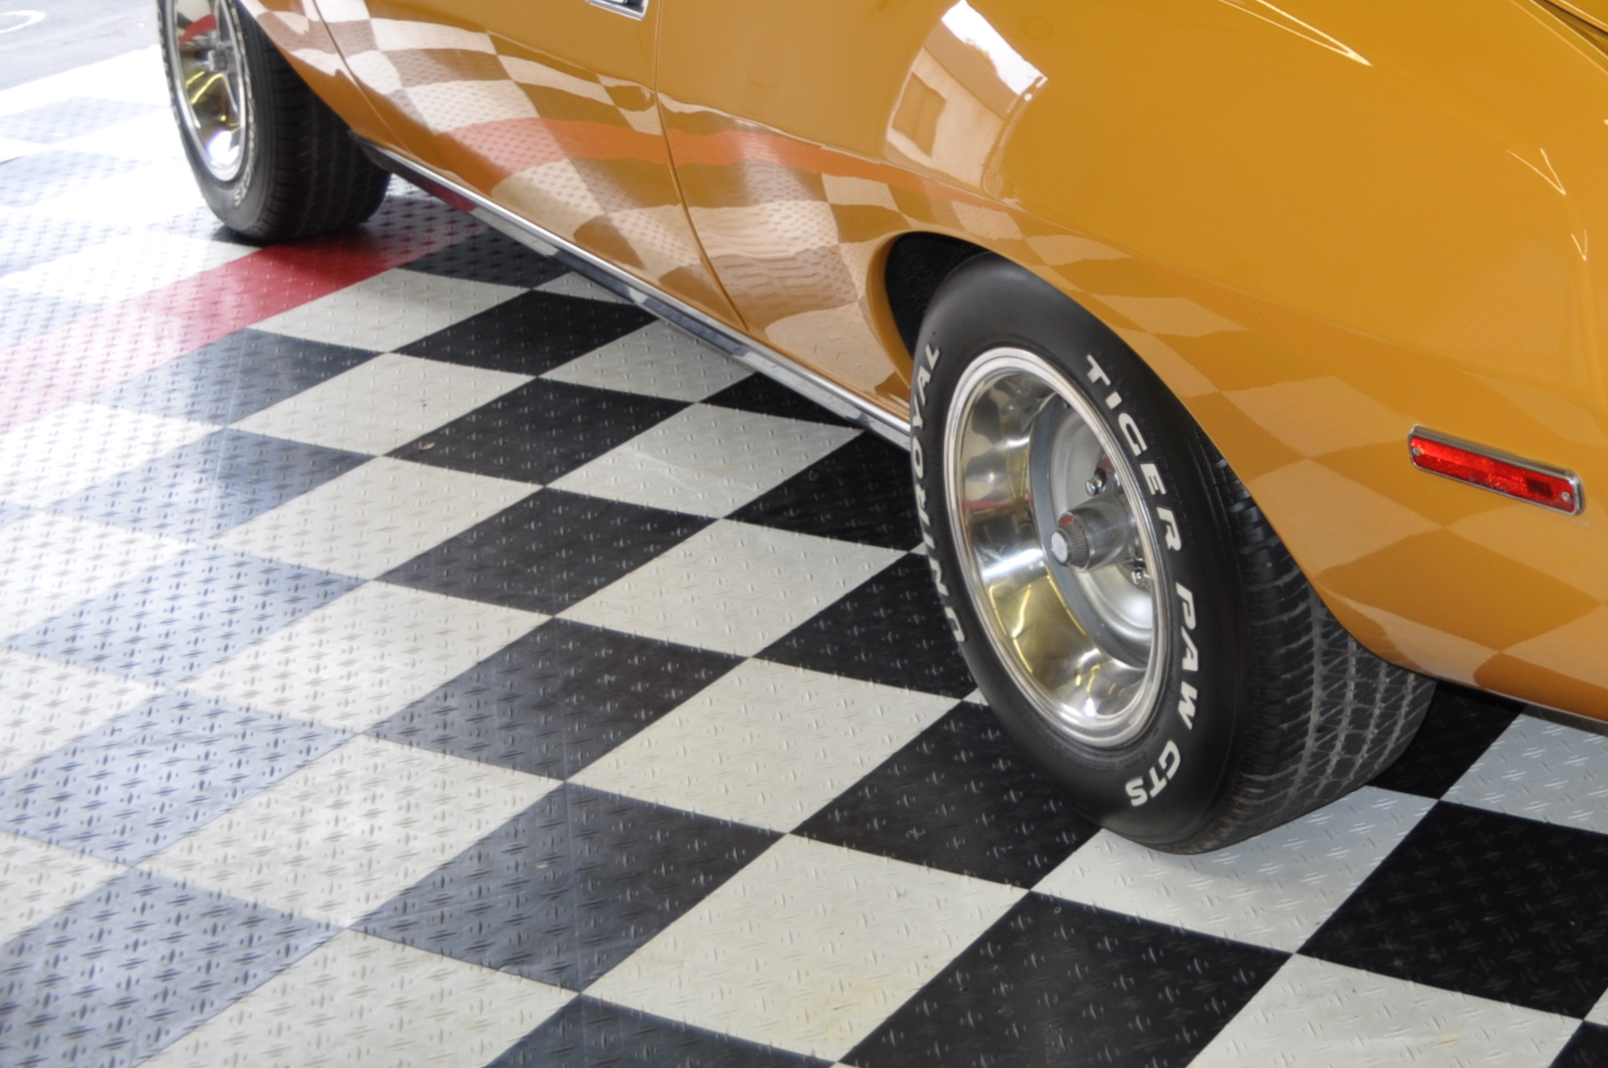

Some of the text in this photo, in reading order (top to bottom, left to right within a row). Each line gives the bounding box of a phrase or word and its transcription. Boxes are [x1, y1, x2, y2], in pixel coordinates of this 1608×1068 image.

[910, 344, 967, 642] UNIROYAL
[1086, 354, 1199, 807] TIGER PAW GTS
